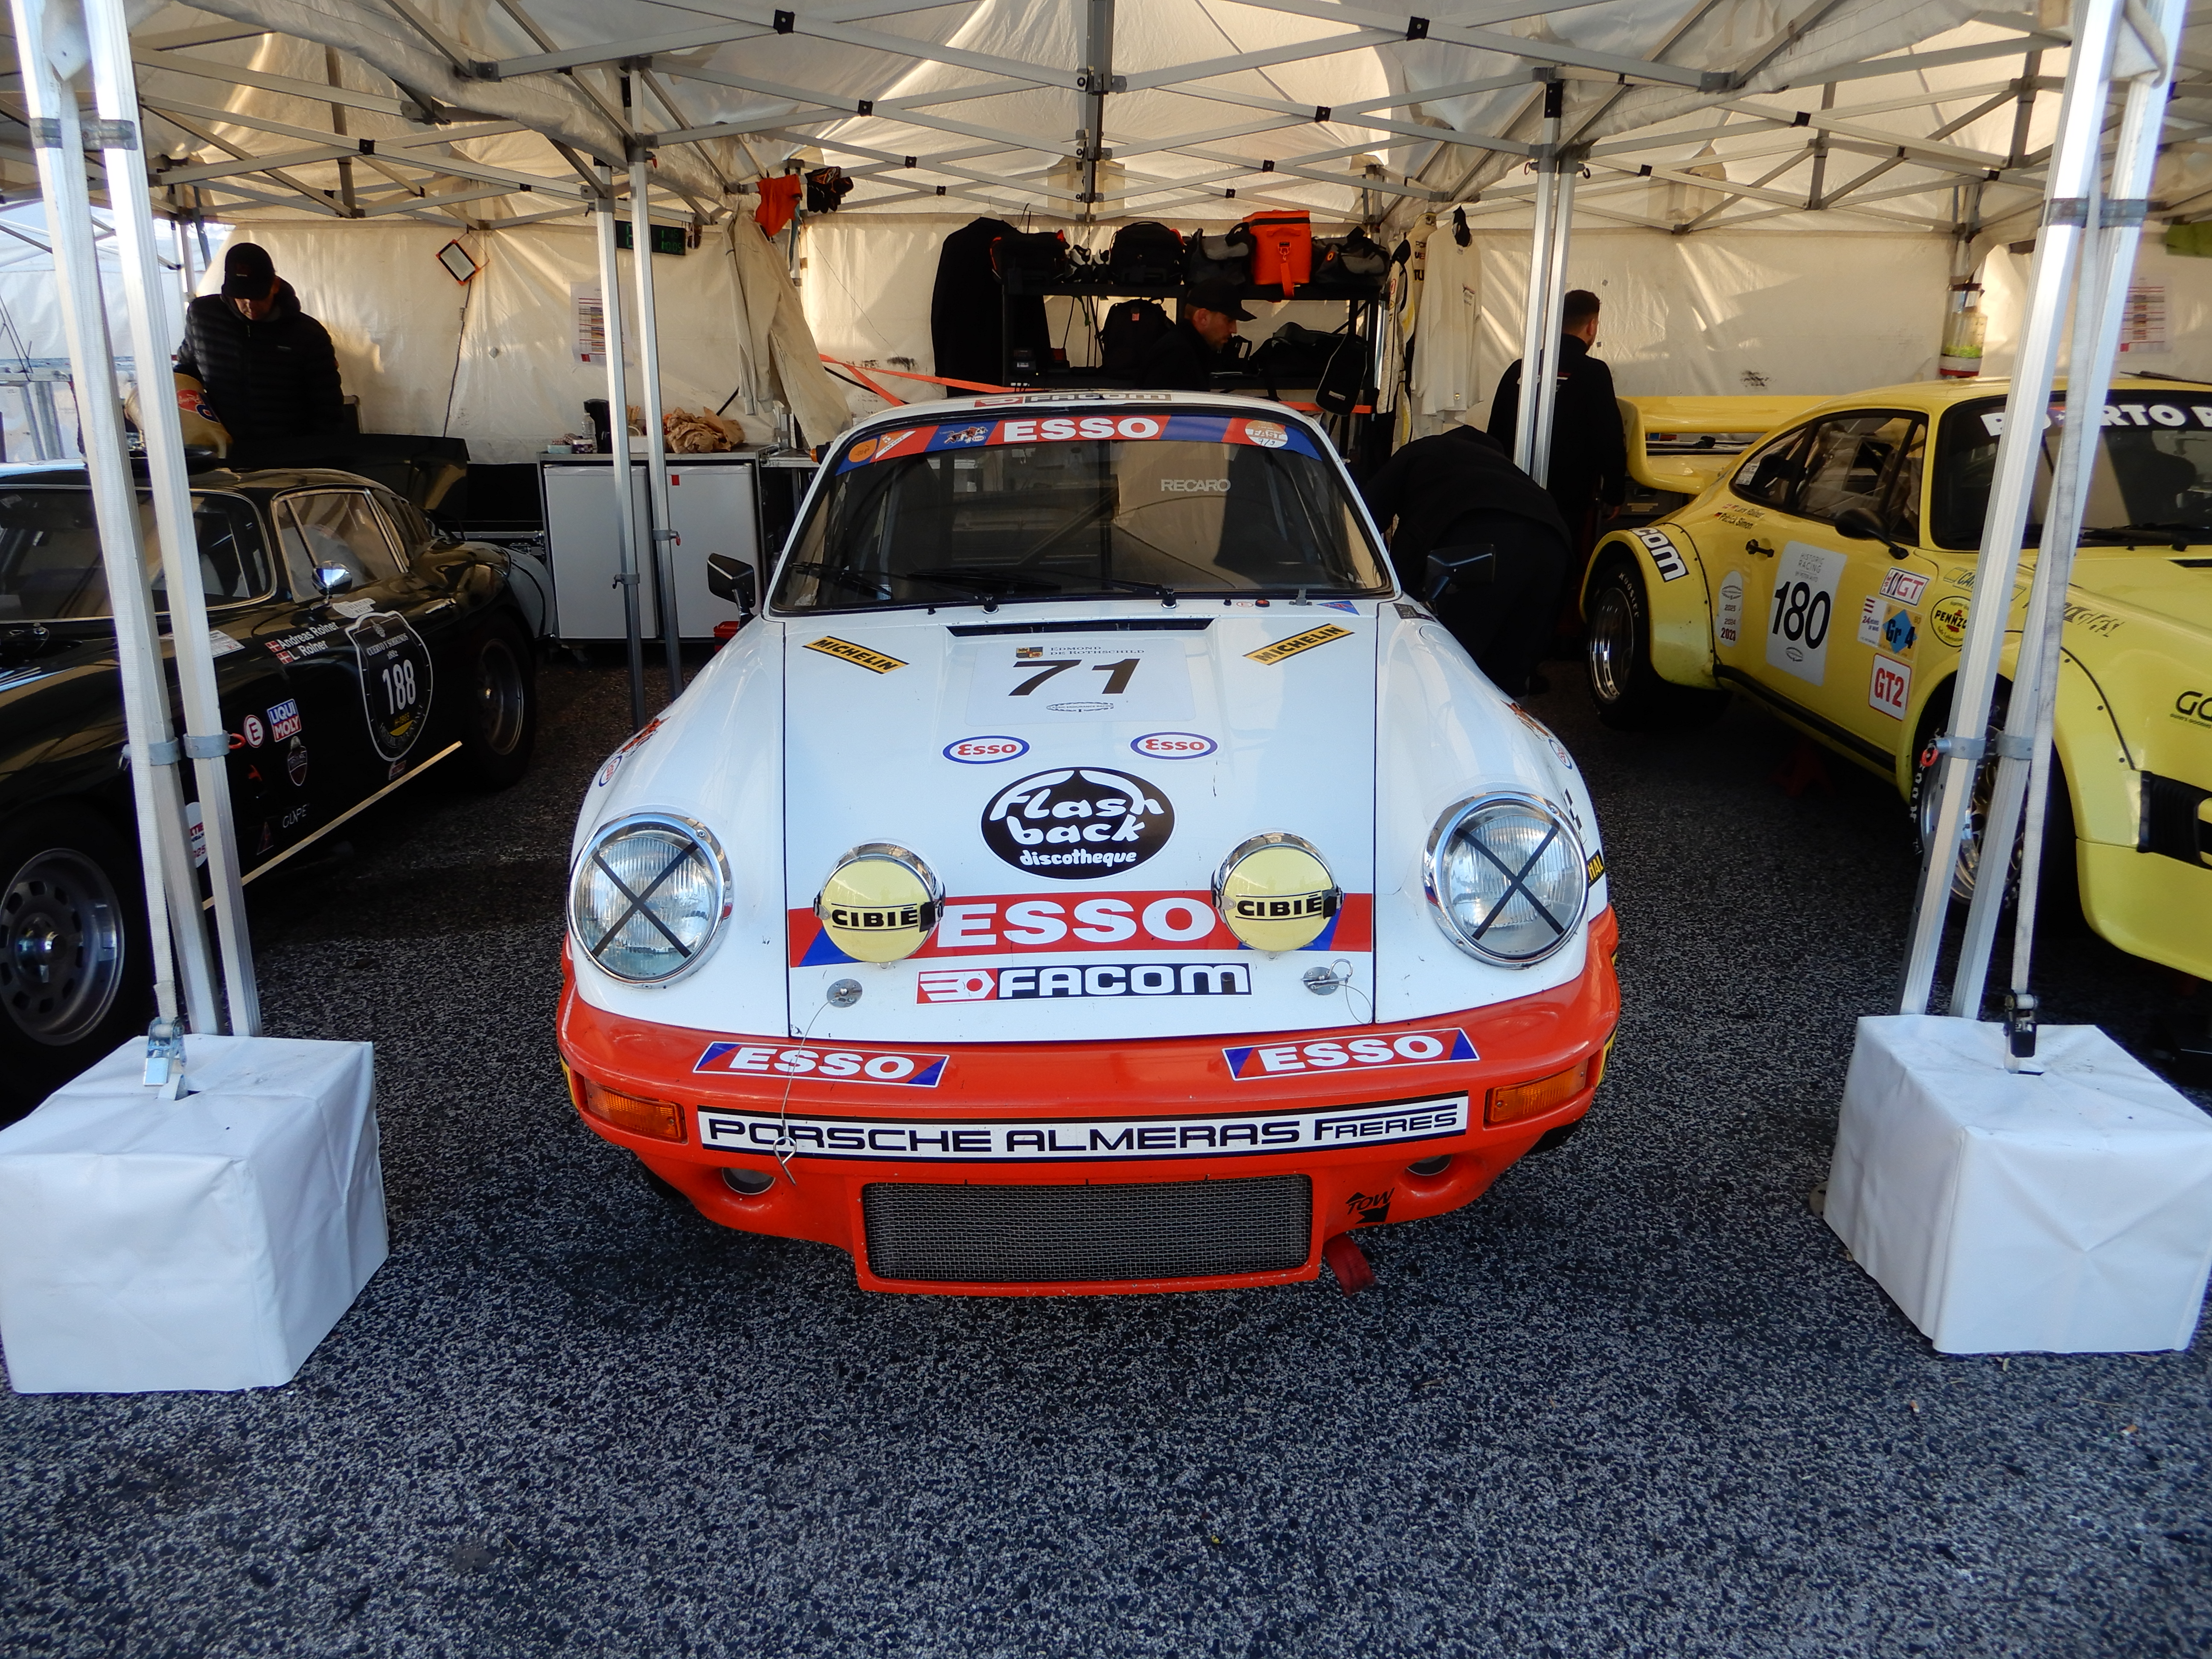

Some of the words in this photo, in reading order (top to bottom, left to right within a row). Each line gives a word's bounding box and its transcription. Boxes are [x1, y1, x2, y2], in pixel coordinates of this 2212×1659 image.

[1004, 418, 1159, 442] ESSO
[1161, 479, 1231, 492] RECARO
[1798, 559, 1822, 573] RACING
[1897, 576, 1924, 599] GT
[1773, 581, 1831, 649] 180
[276, 627, 315, 649] Andreas
[310, 621, 340, 637] Rolner
[1253, 626, 1345, 661] MICHELIN
[1720, 627, 1736, 641] 2023
[1904, 626, 1915, 649] 4
[299, 640, 329, 657] Rolner
[812, 639, 898, 670] MICHELIN
[382, 659, 416, 715] 188
[1008, 658, 1141, 696] 71
[1874, 667, 1904, 707] GT2
[270, 702, 297, 722] LIQUI
[250, 722, 260, 741] E
[274, 717, 299, 740] MOLY
[957, 744, 1017, 755] Esso
[1145, 739, 1205, 751] Esso
[989, 770, 1164, 821] Flash
[1007, 814, 1145, 844] back
[1019, 848, 1137, 867] discotheque
[937, 897, 1216, 947] ESSO
[999, 966, 1249, 998] FACOM
[729, 1047, 915, 1079] ESSO
[1258, 1035, 1444, 1072] ESSO
[708, 1118, 992, 1152] PORSCHE
[1006, 1121, 1300, 1152] ALMERAS
[1347, 1187, 1395, 1215] TOW
